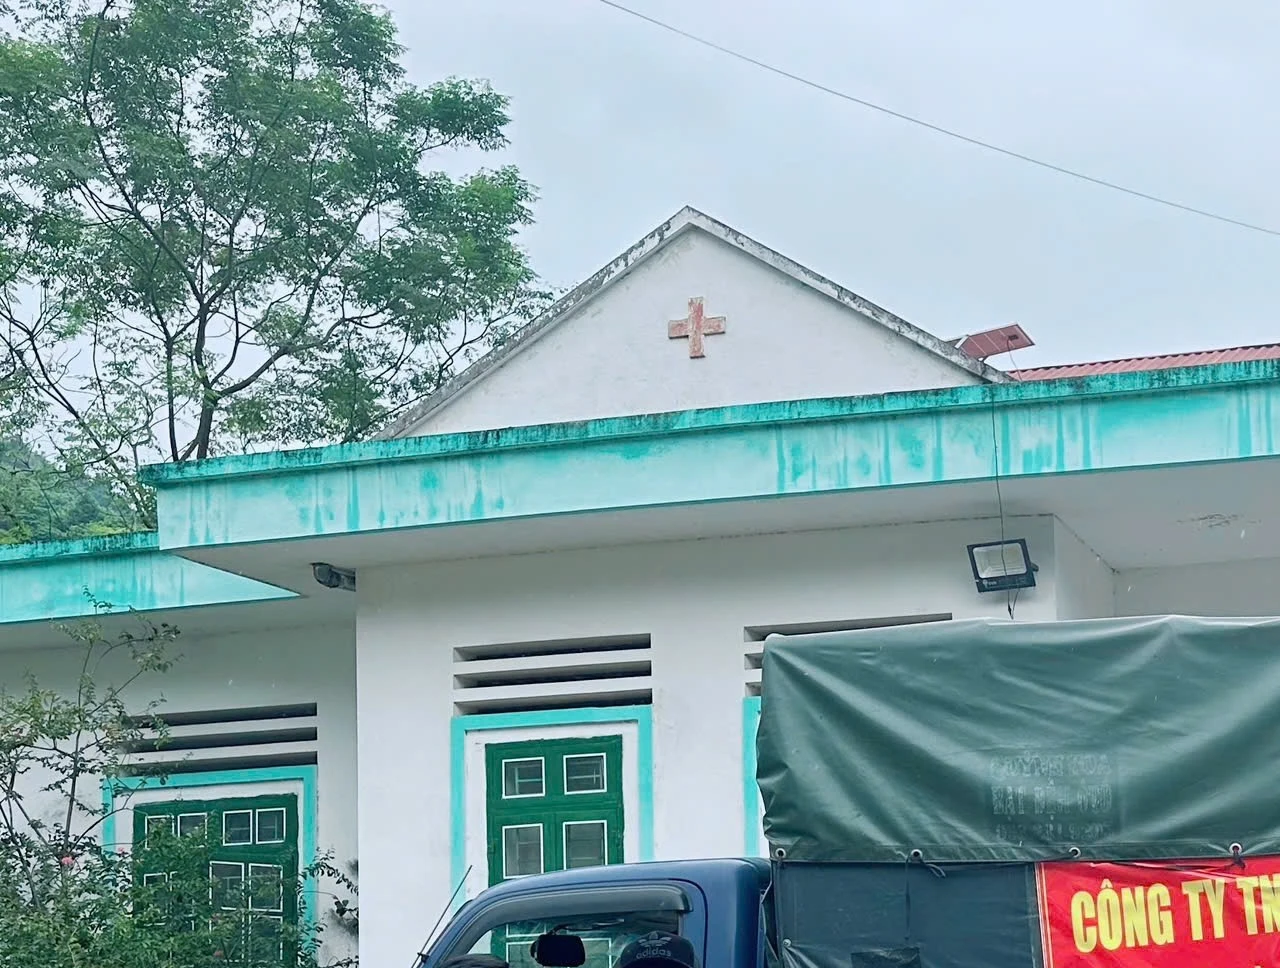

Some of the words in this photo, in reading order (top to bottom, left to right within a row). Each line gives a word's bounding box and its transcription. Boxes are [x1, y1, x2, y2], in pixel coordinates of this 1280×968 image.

[1070, 879, 1175, 953] CÔNG
[1182, 880, 1226, 941] TY
[636, 946, 672, 960] adidas
